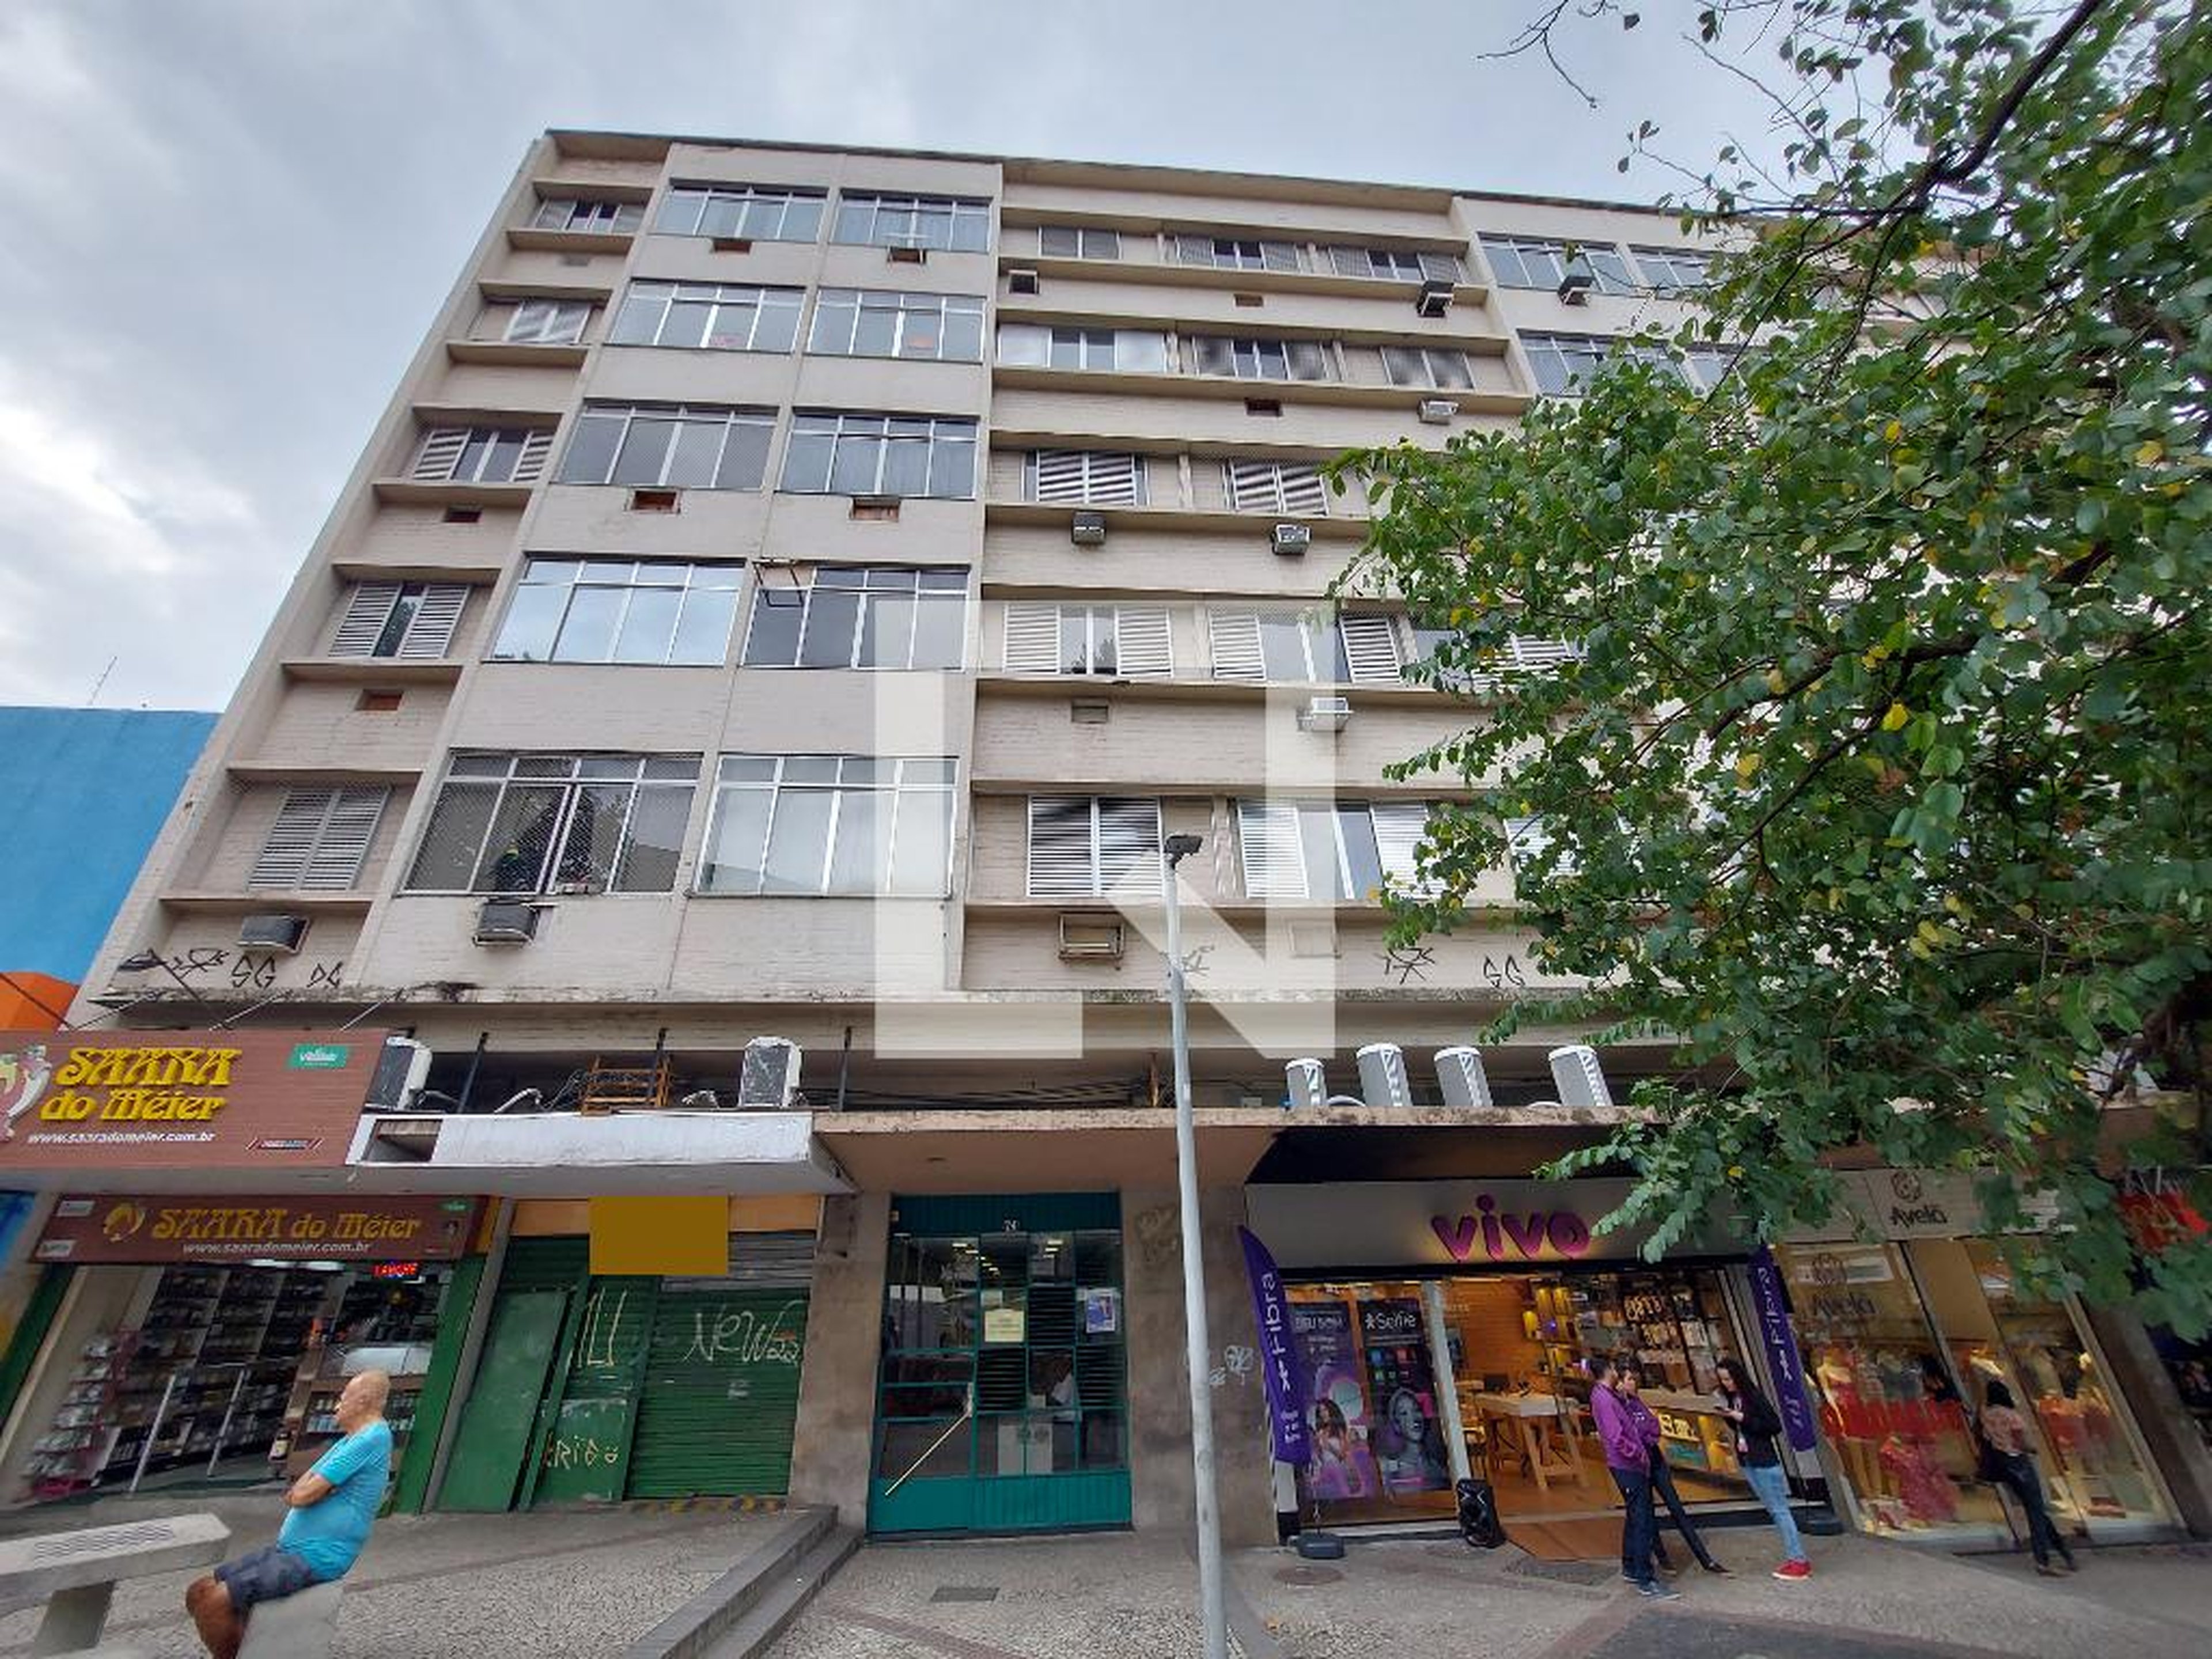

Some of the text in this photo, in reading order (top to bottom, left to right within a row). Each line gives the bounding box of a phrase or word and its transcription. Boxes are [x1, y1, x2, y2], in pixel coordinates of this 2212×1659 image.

[55, 1046, 243, 1086] SAARA
[39, 1088, 228, 1120] do Méier
[151, 1209, 422, 1239] SAARA do Méier
[1431, 1194, 1590, 1261] vivo
